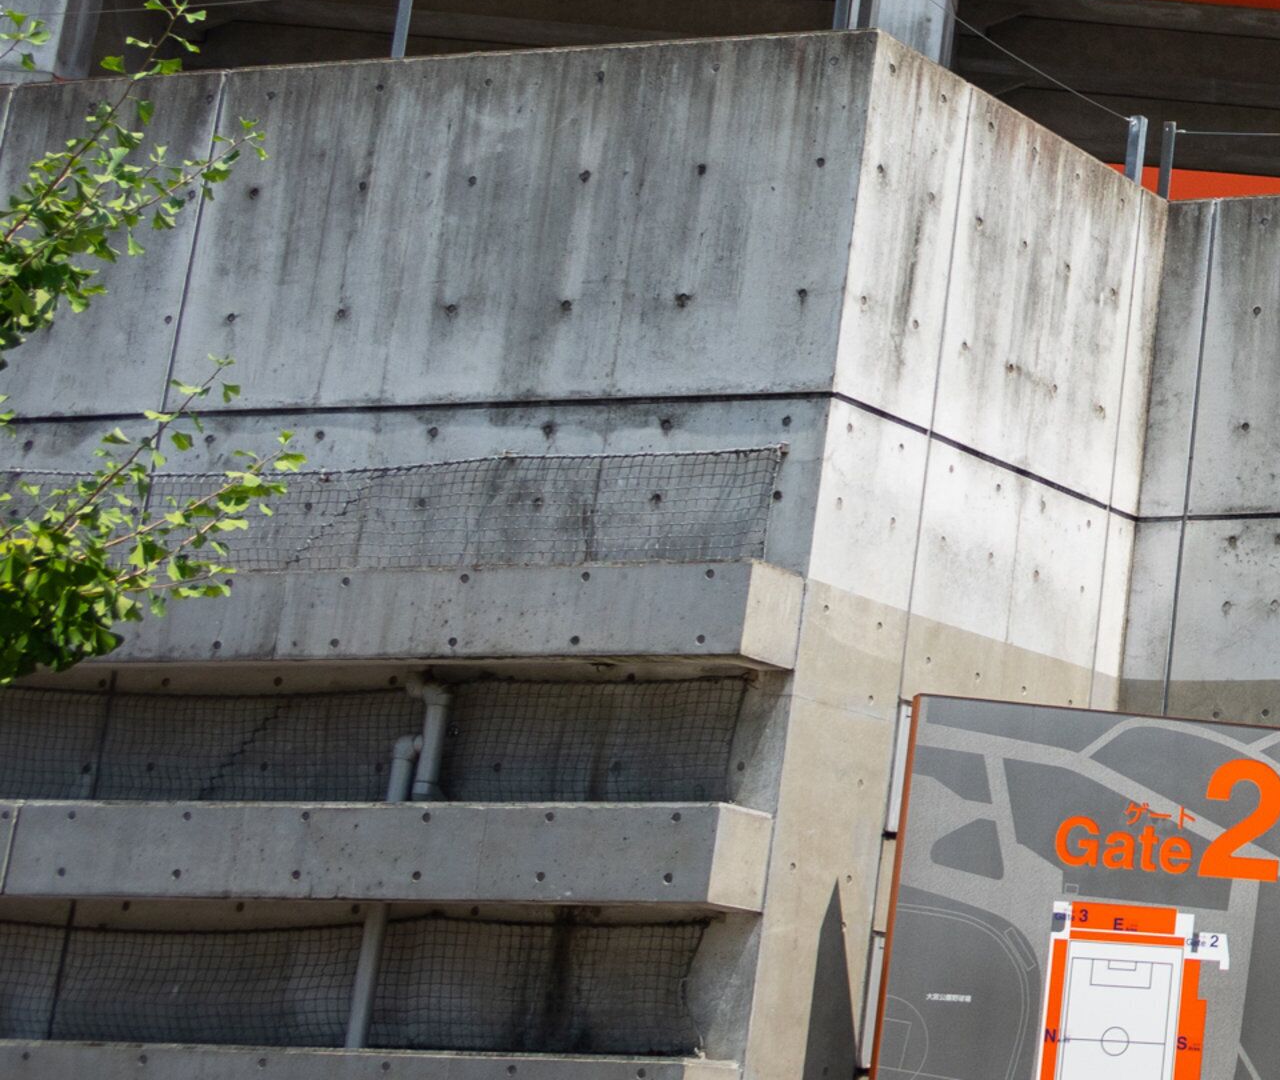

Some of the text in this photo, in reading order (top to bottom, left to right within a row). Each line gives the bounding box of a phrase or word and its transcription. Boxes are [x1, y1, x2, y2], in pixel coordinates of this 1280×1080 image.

[1123, 802, 1196, 829] ゲート
[1055, 815, 1193, 875] Gate
[1079, 909, 1089, 922] 3
[1113, 917, 1125, 931] E
[1209, 935, 1220, 948] 2
[1044, 1029, 1057, 1042] N
[1176, 1035, 1188, 1050] S
